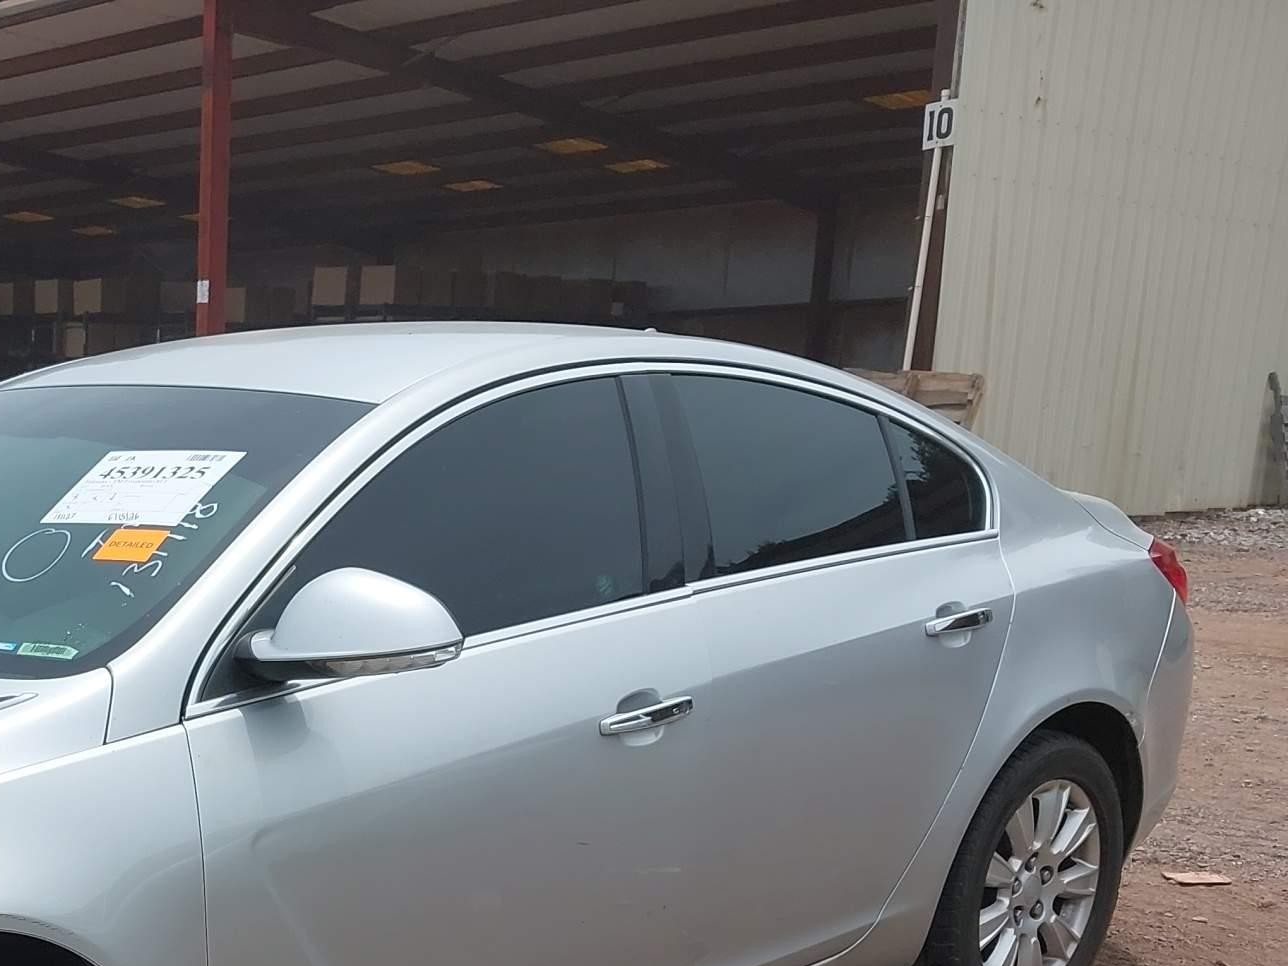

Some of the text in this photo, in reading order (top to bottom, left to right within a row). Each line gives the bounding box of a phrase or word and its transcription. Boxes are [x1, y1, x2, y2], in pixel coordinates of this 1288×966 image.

[927, 107, 954, 141] 10
[99, 465, 211, 480] 45391325
[109, 540, 155, 549] DETAILED
